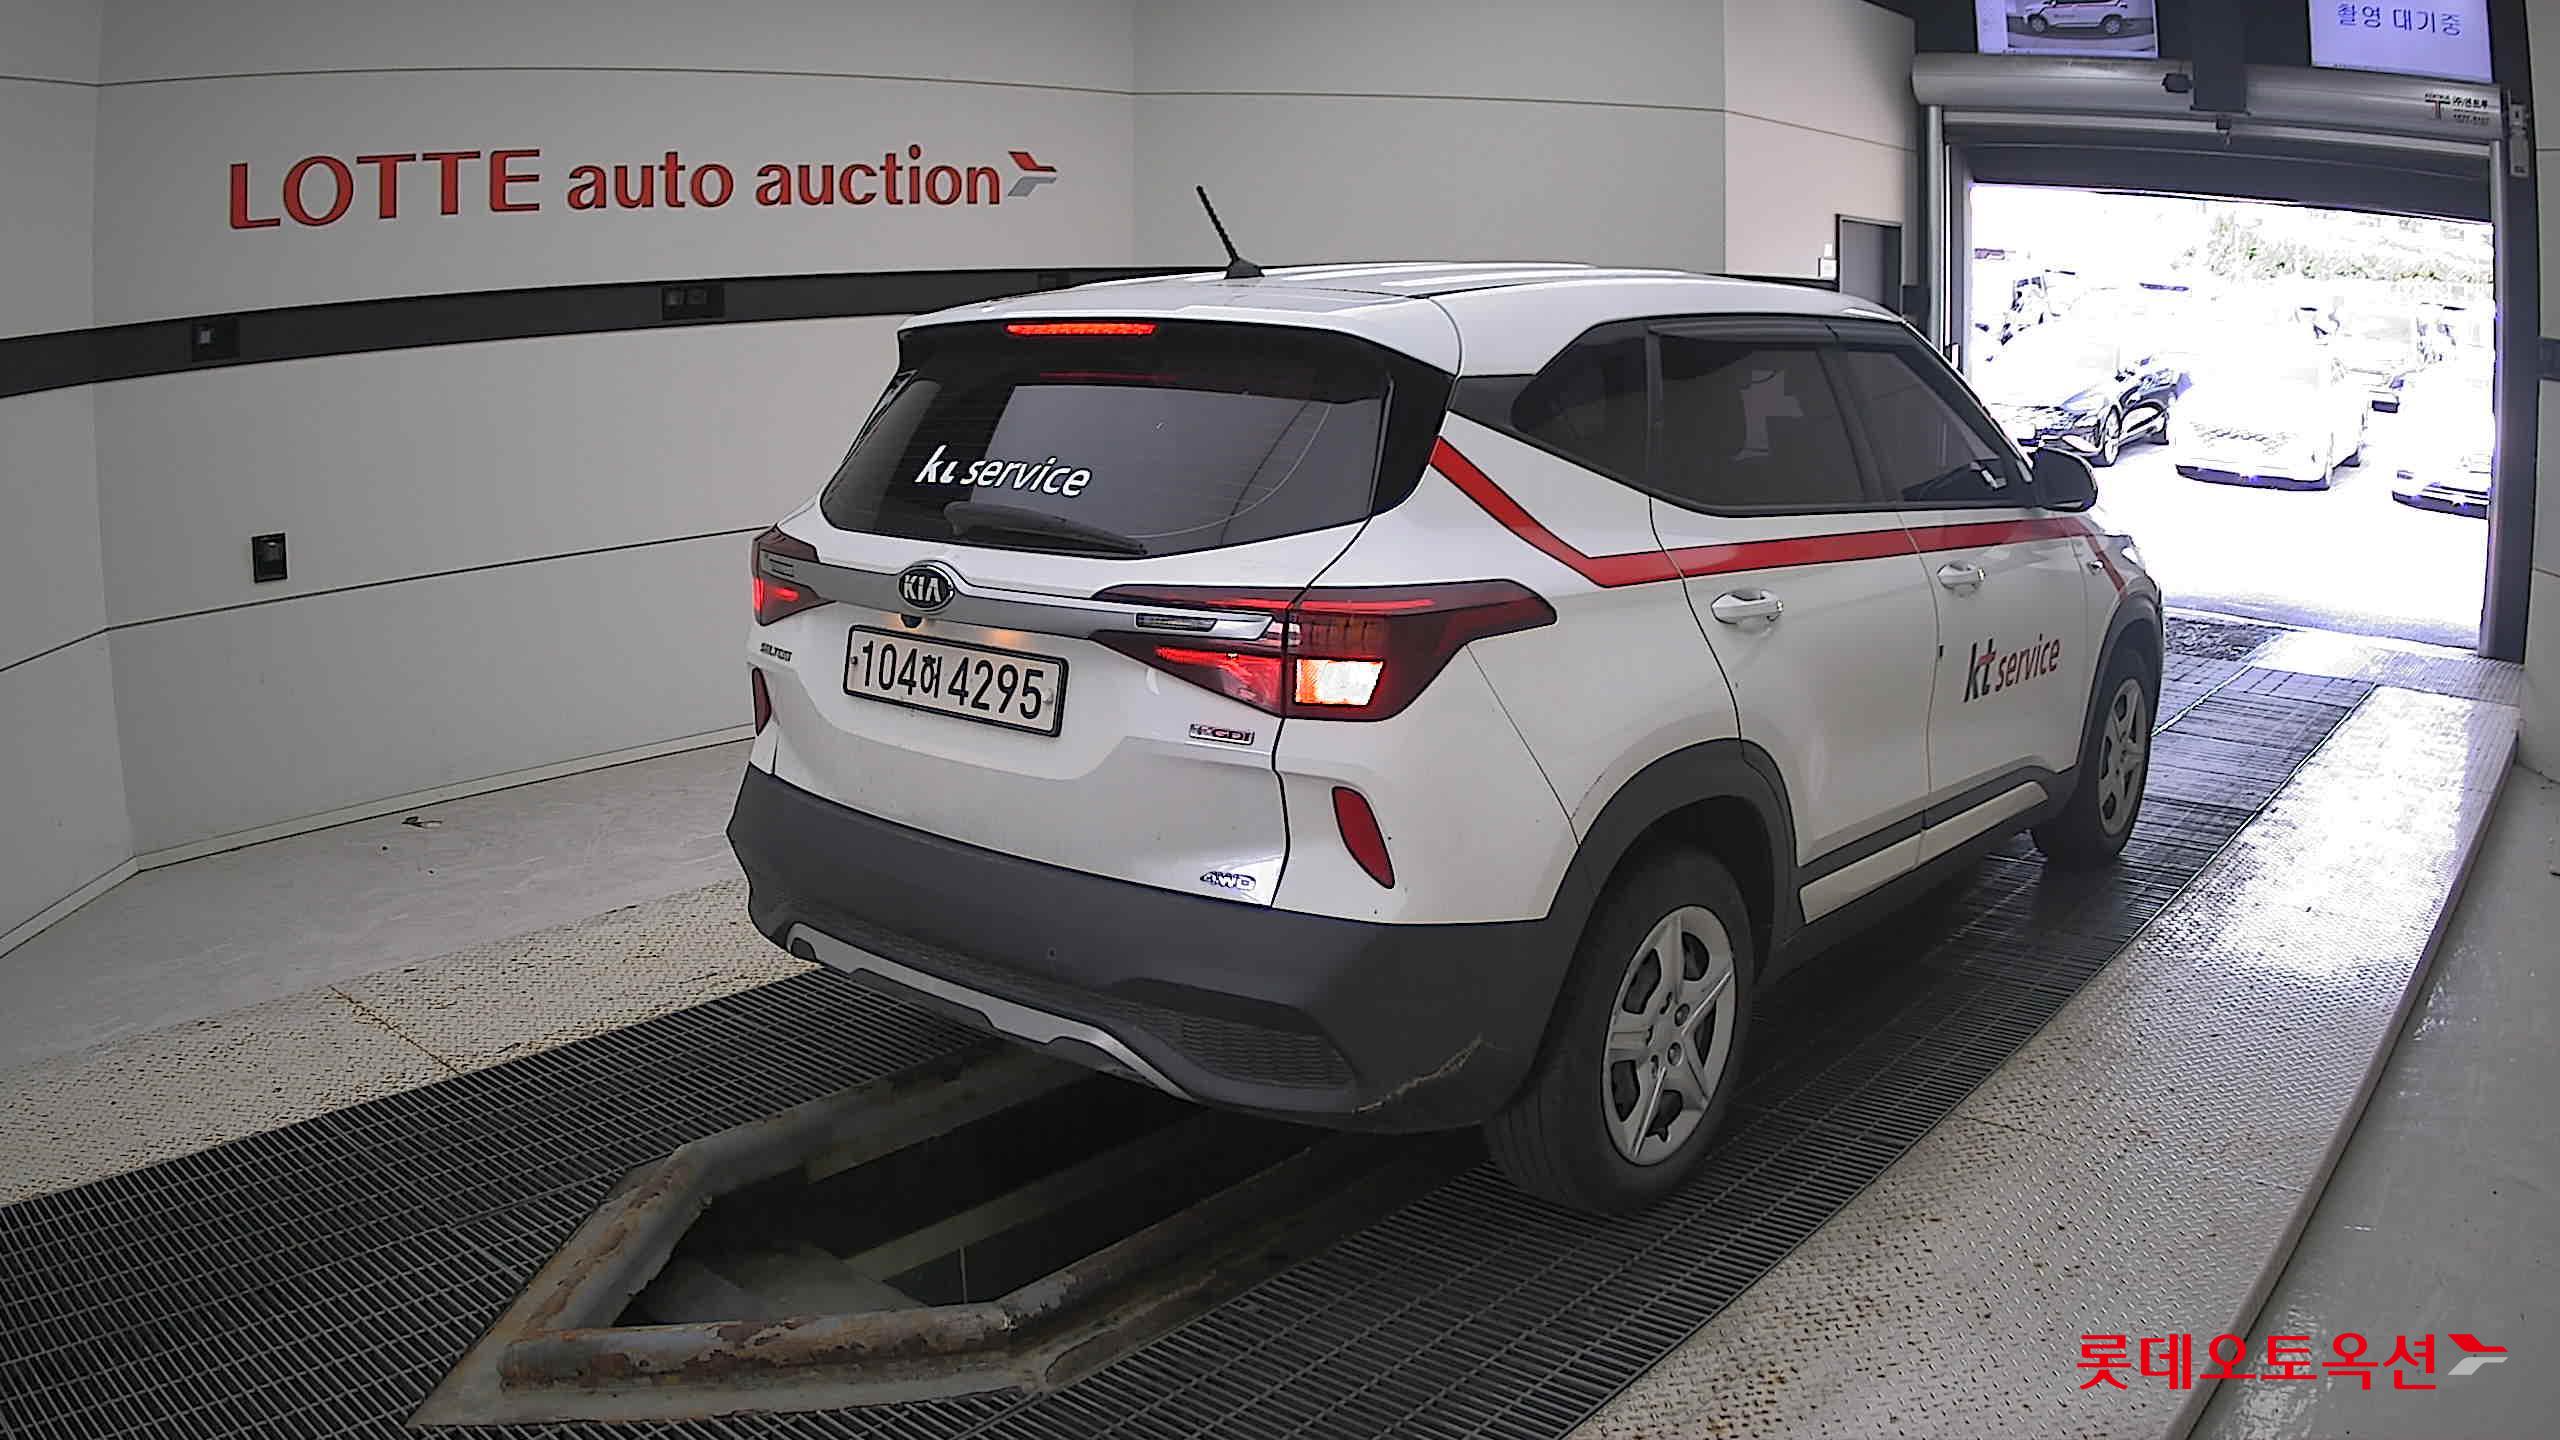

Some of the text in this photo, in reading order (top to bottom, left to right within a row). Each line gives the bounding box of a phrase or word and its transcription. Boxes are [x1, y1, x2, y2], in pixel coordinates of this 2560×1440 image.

[2337, 3, 2461, 37] 촬영 대기중
[229, 144, 1001, 230] LOTTE auto auction
[959, 456, 1092, 498] service
[902, 574, 942, 603] KIA
[1963, 632, 2061, 703] kt service
